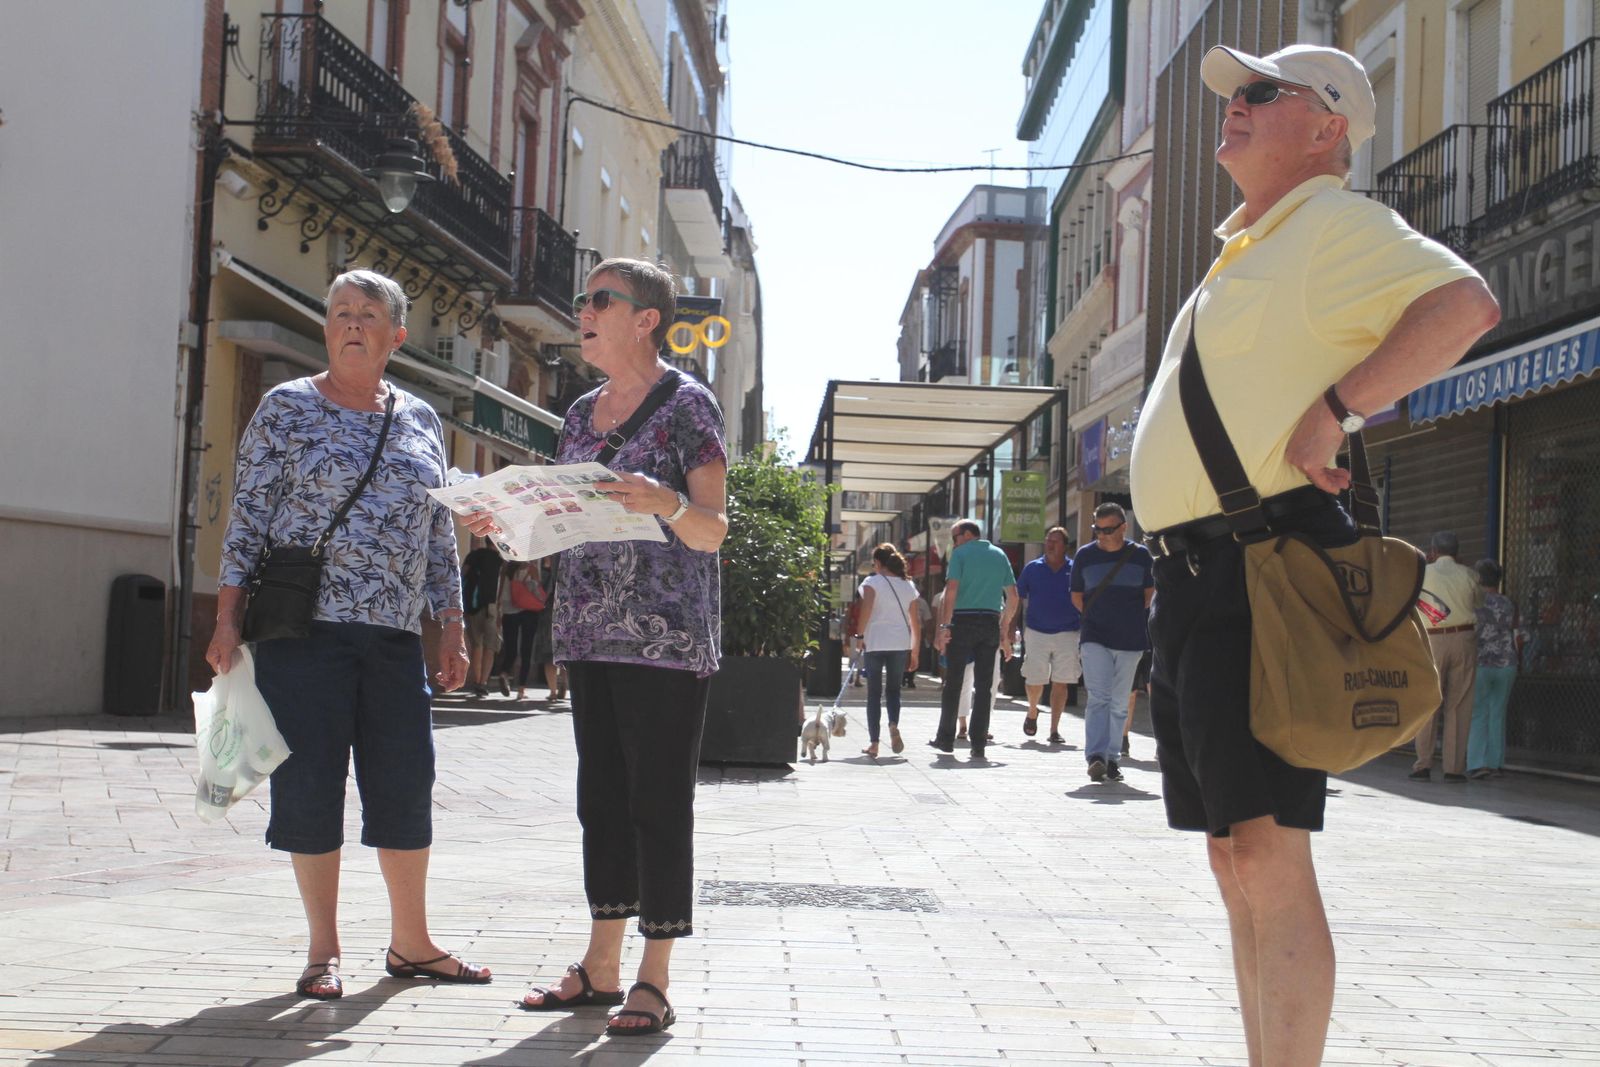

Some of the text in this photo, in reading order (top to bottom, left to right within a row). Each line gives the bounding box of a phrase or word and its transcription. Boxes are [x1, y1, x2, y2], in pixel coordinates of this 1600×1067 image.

[1455, 340, 1581, 405] LOS ANGELES
[1006, 488, 1041, 498] ZONA
[1006, 513, 1041, 524] AREA
[1343, 667, 1409, 691] RA-CANADA
